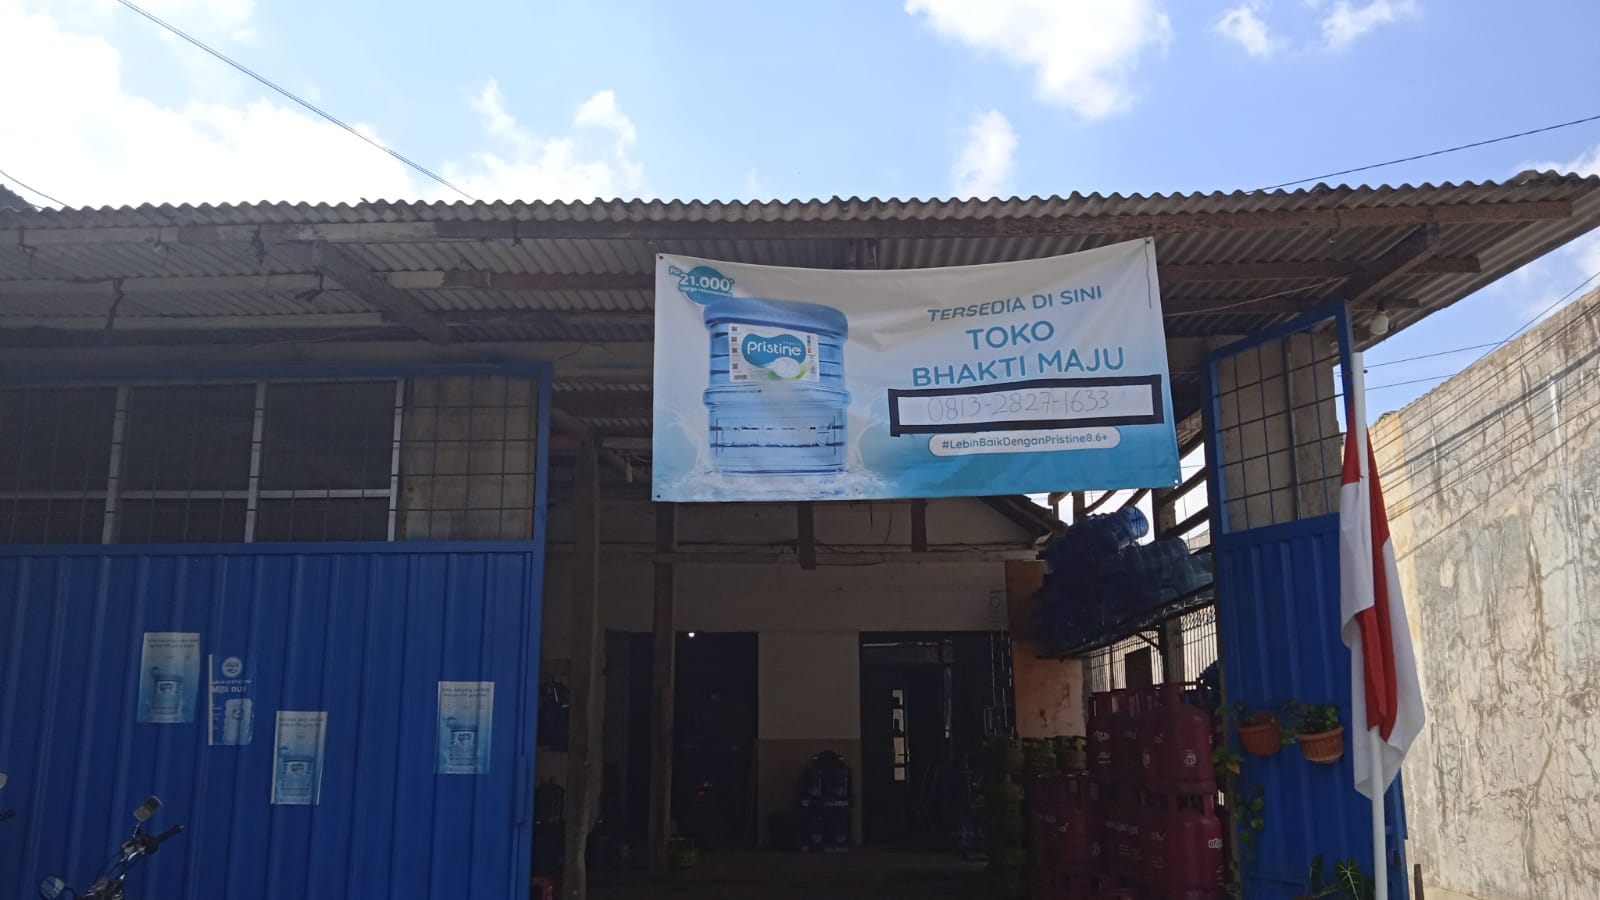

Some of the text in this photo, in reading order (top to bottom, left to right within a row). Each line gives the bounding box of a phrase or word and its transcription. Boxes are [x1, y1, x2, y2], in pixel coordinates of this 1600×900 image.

[927, 286, 1102, 322] TERSEDIA DI SINI
[966, 320, 1055, 350] TOKO
[912, 347, 1125, 387] BHAKTI MAJU
[927, 390, 1110, 422] 0813-2827-1633
[941, 433, 1108, 449] #LebihBaikDenganPristine8.6+
